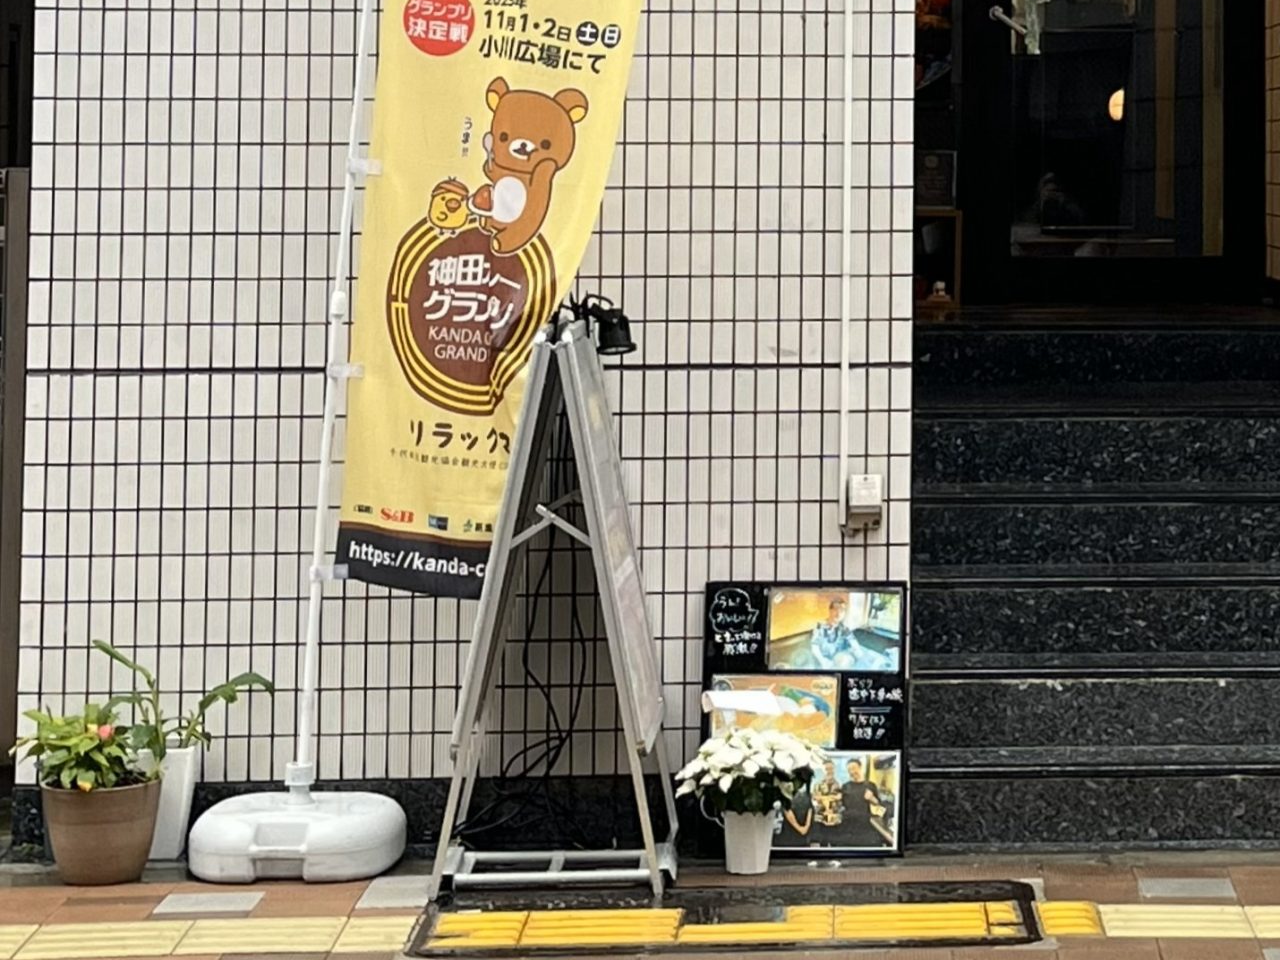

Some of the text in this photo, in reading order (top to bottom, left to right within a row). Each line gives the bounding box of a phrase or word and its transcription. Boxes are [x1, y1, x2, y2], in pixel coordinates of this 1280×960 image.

[407, 18, 469, 44] 決定戦
[479, 35, 607, 74] 小川広場にて
[428, 325, 483, 345] KANDA
[434, 344, 488, 363] GRAND
[380, 507, 415, 524] S&B
[348, 540, 488, 579] https://kanda-c
